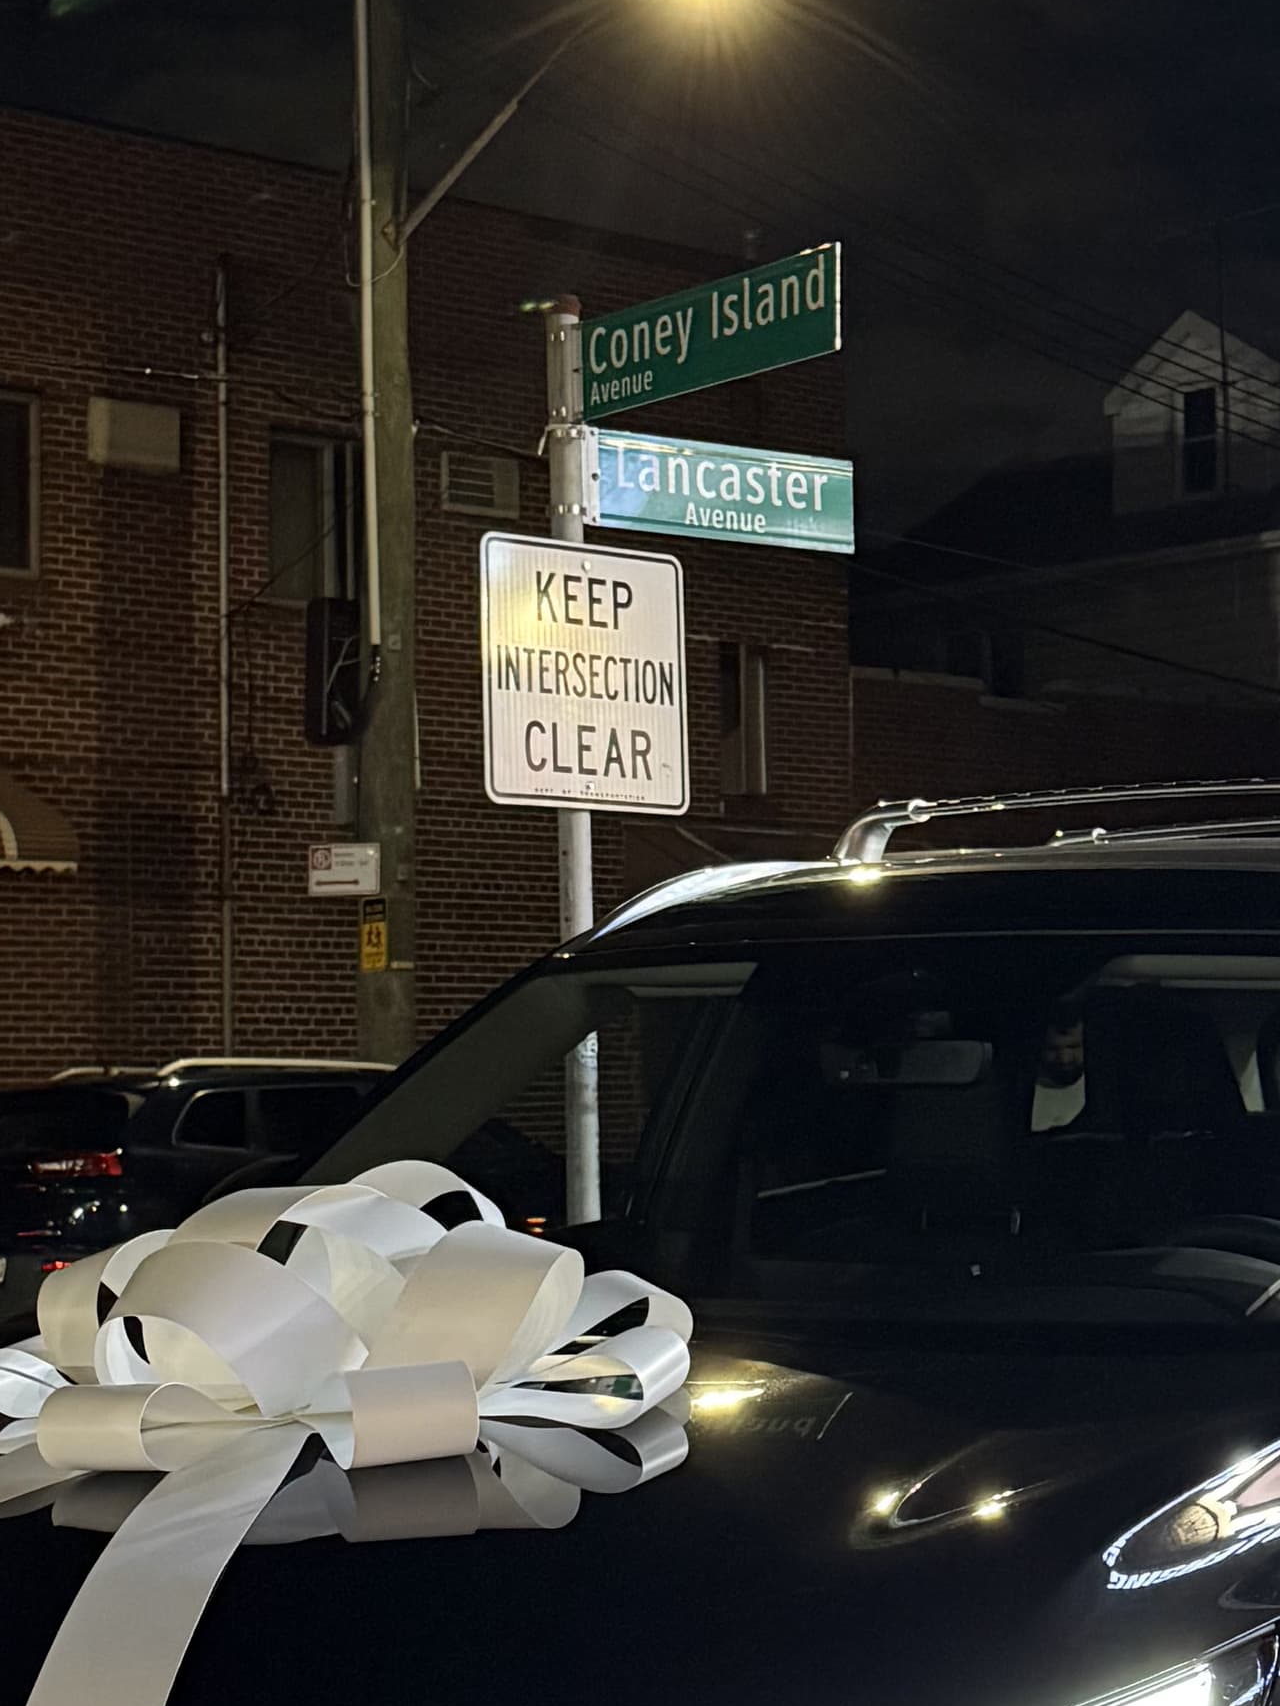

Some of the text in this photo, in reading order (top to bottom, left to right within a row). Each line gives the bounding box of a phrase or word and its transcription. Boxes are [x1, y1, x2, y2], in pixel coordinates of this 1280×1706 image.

[589, 254, 825, 374] Coney Island
[590, 369, 653, 406] Avenue
[616, 445, 828, 511] Lancaster
[684, 501, 767, 533] Avenue
[536, 570, 633, 630] KEEP
[496, 644, 674, 706] INTERSECTION
[524, 720, 652, 781] CLEAR
